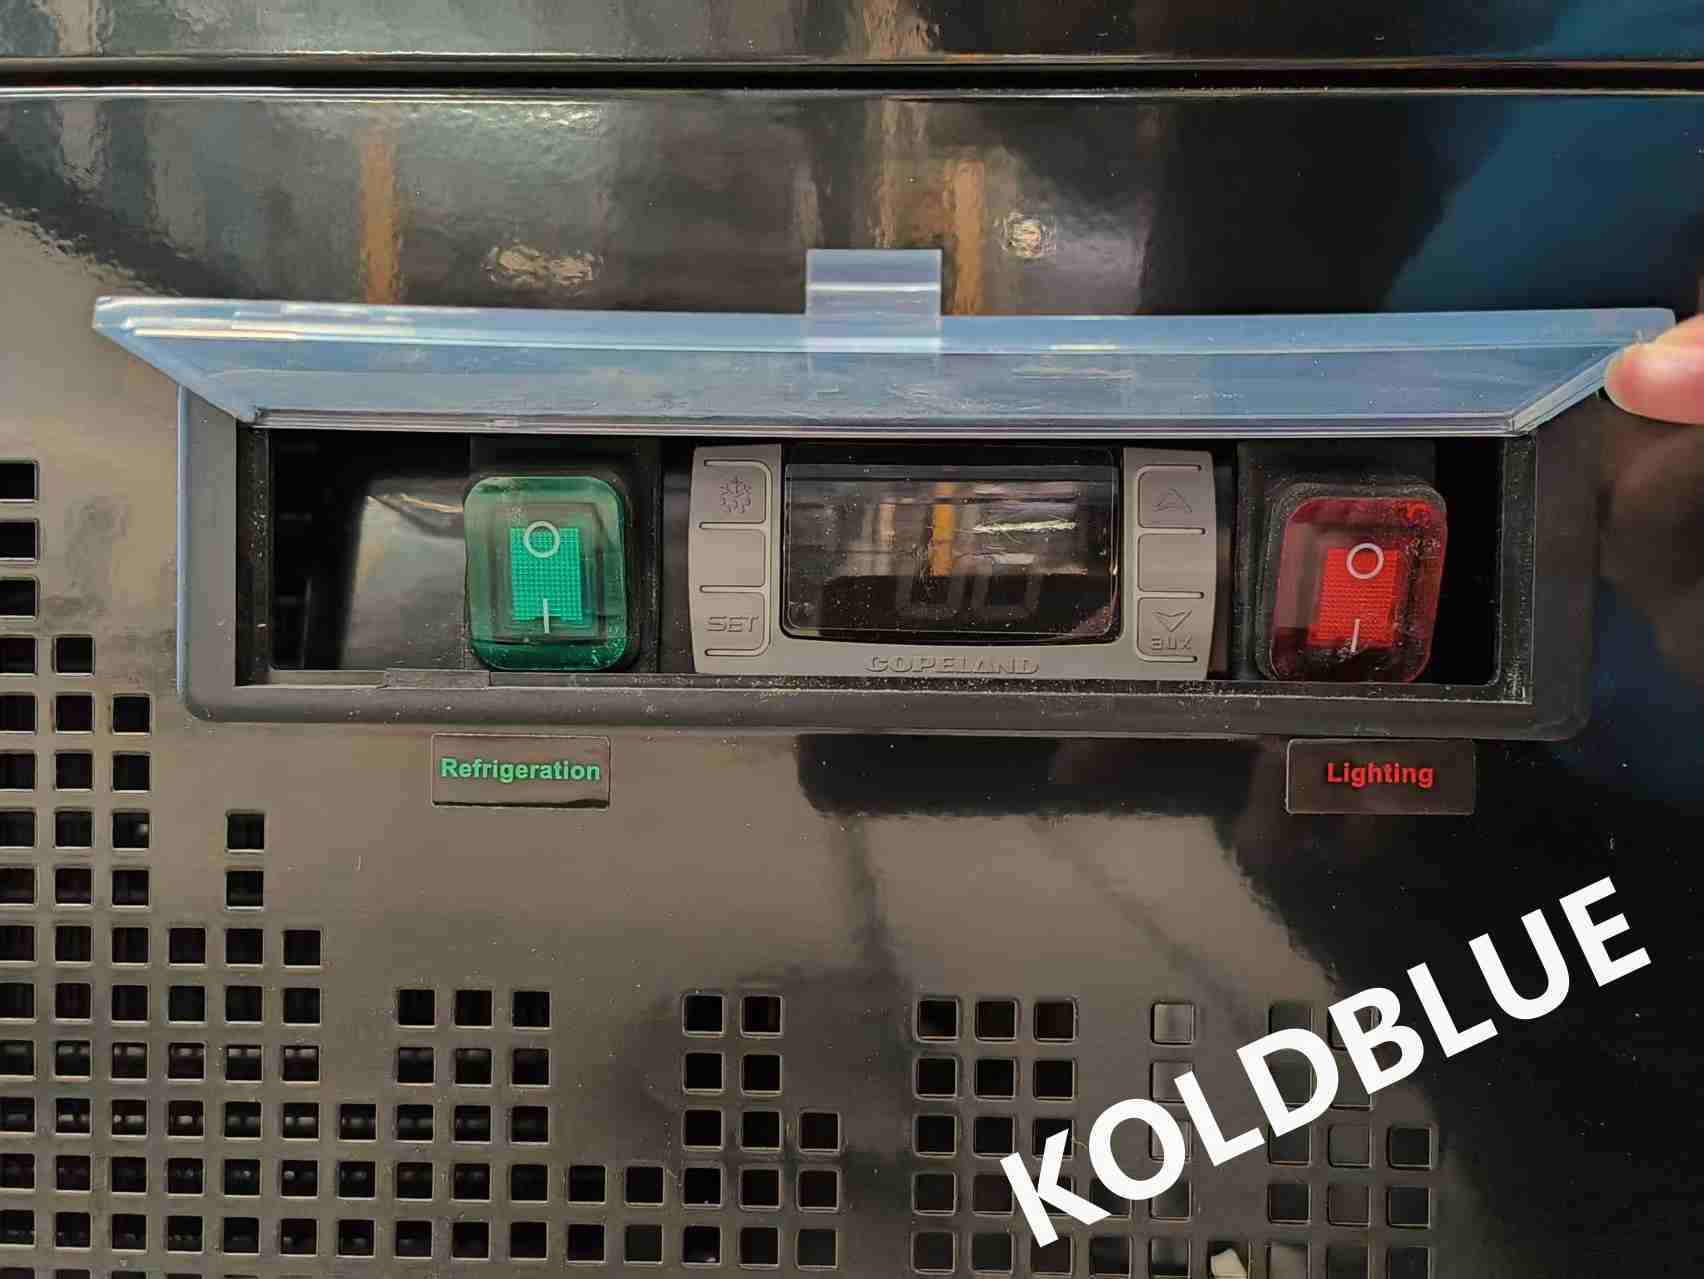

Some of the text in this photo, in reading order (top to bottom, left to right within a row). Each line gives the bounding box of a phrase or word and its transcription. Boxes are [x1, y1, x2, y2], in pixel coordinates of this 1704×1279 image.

[706, 615, 759, 632] SET
[864, 655, 1040, 674] COPELAND
[440, 757, 601, 784] Refrigeration
[1326, 761, 1434, 789] Lighting
